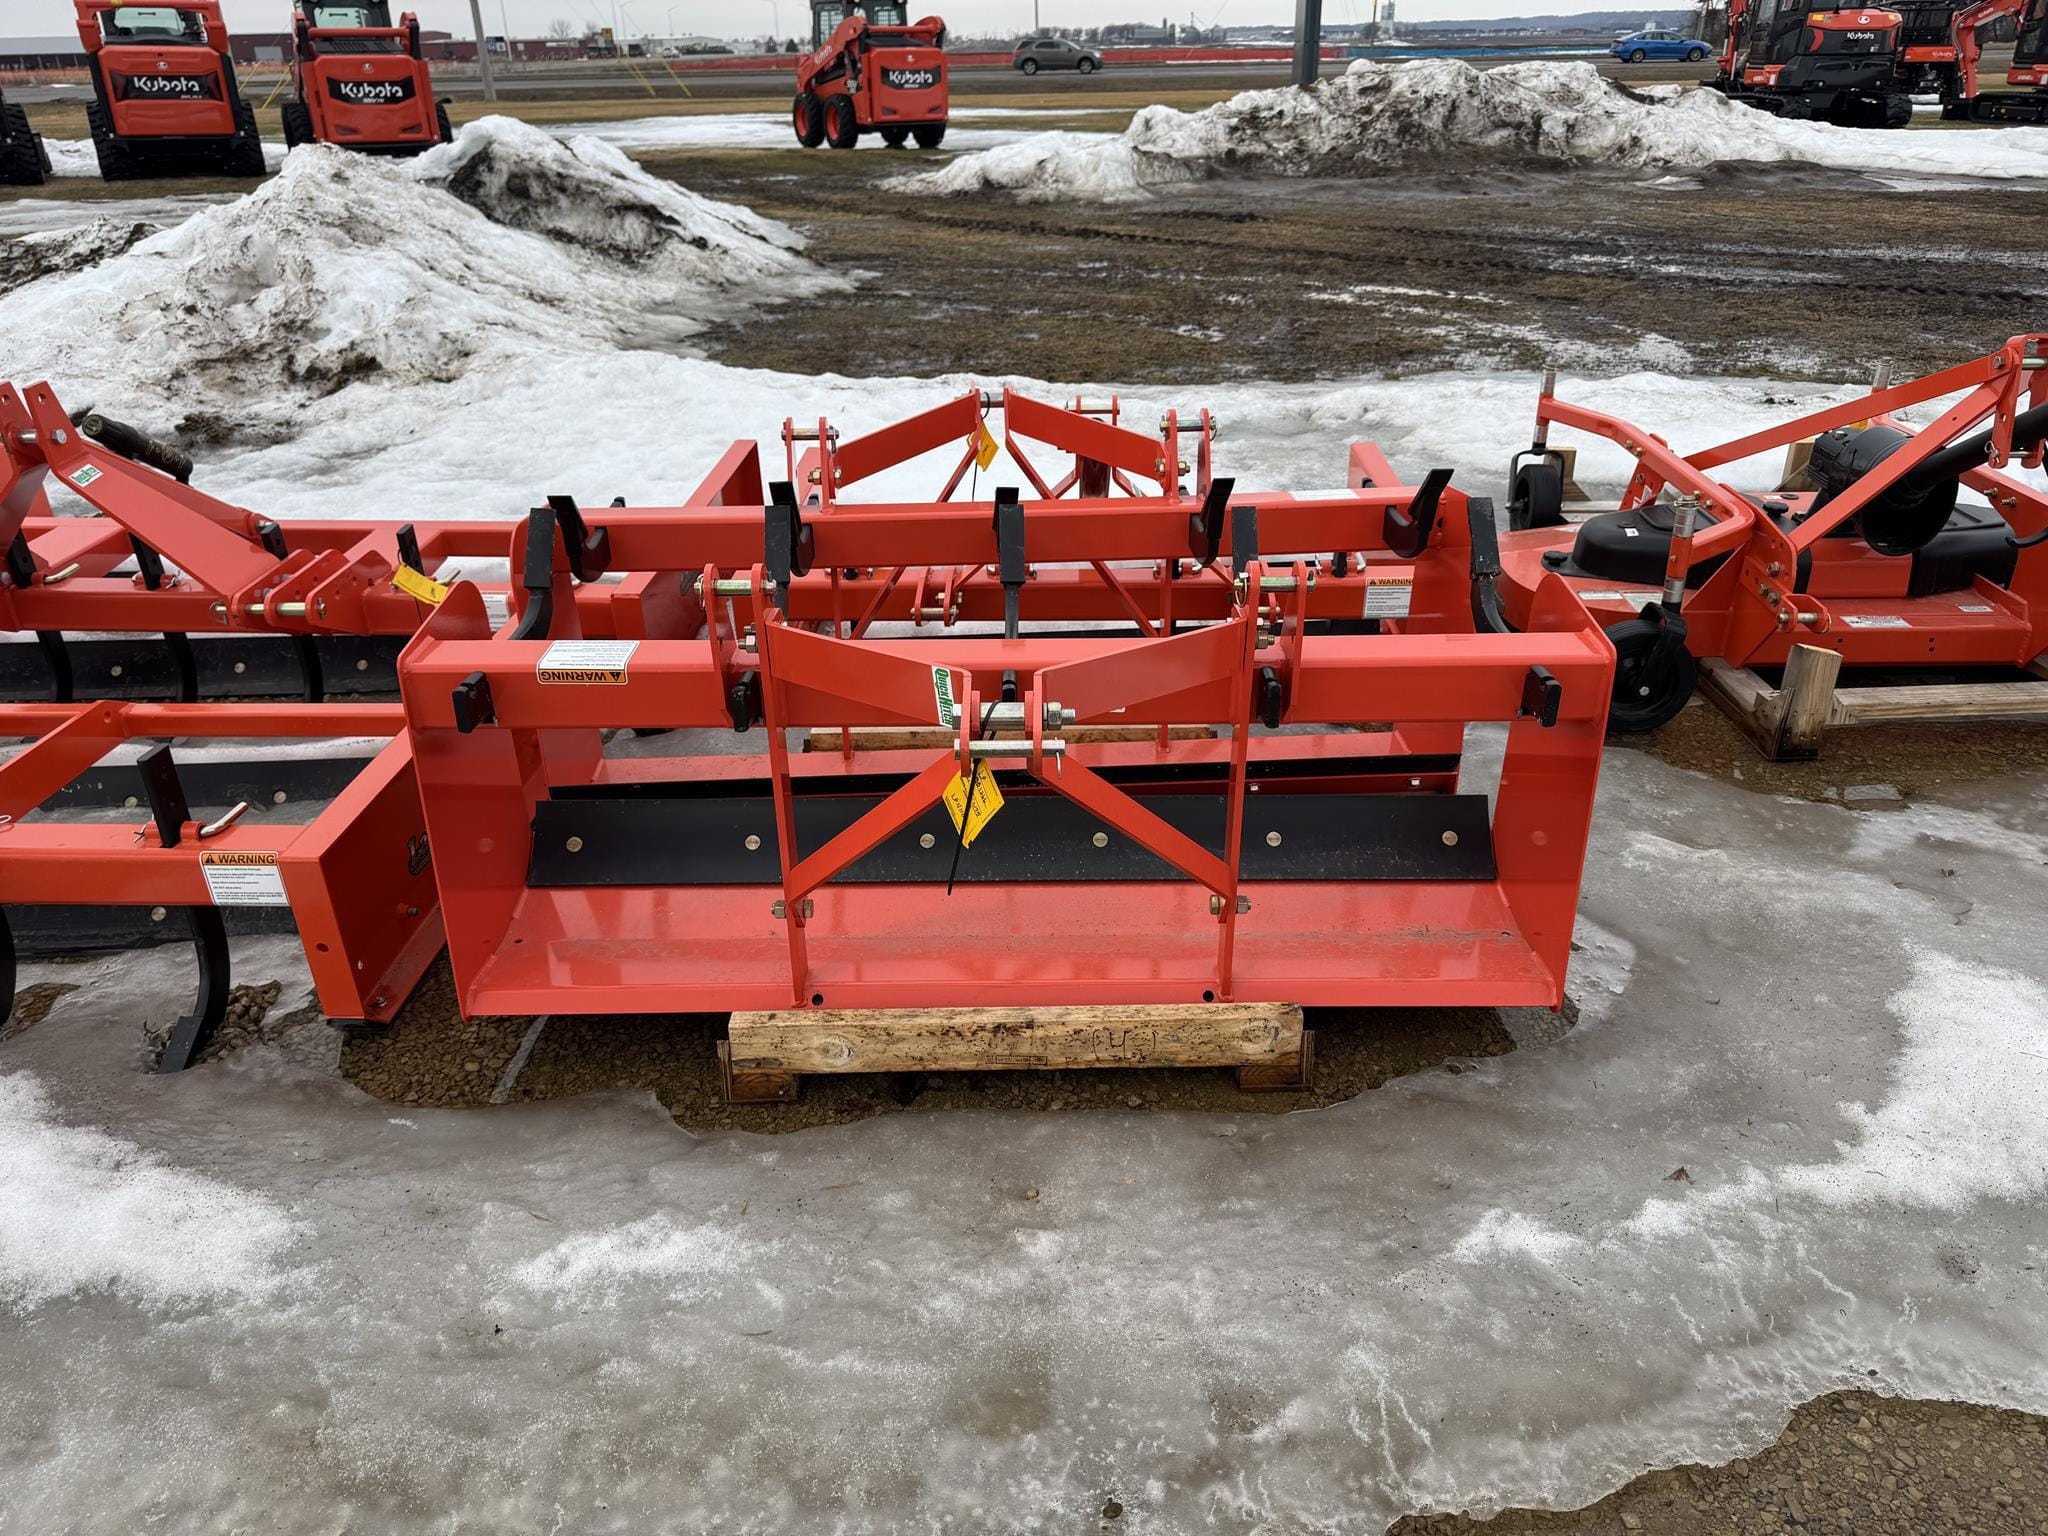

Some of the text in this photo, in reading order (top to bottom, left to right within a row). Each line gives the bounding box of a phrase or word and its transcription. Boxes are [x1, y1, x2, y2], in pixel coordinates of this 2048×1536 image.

[1847, 31, 1874, 39] Kubota
[889, 70, 933, 84] Kubota
[133, 76, 200, 92] Kubota
[340, 82, 404, 97] Kubota
[541, 671, 607, 681] WARNING
[218, 854, 275, 864] WARNING
